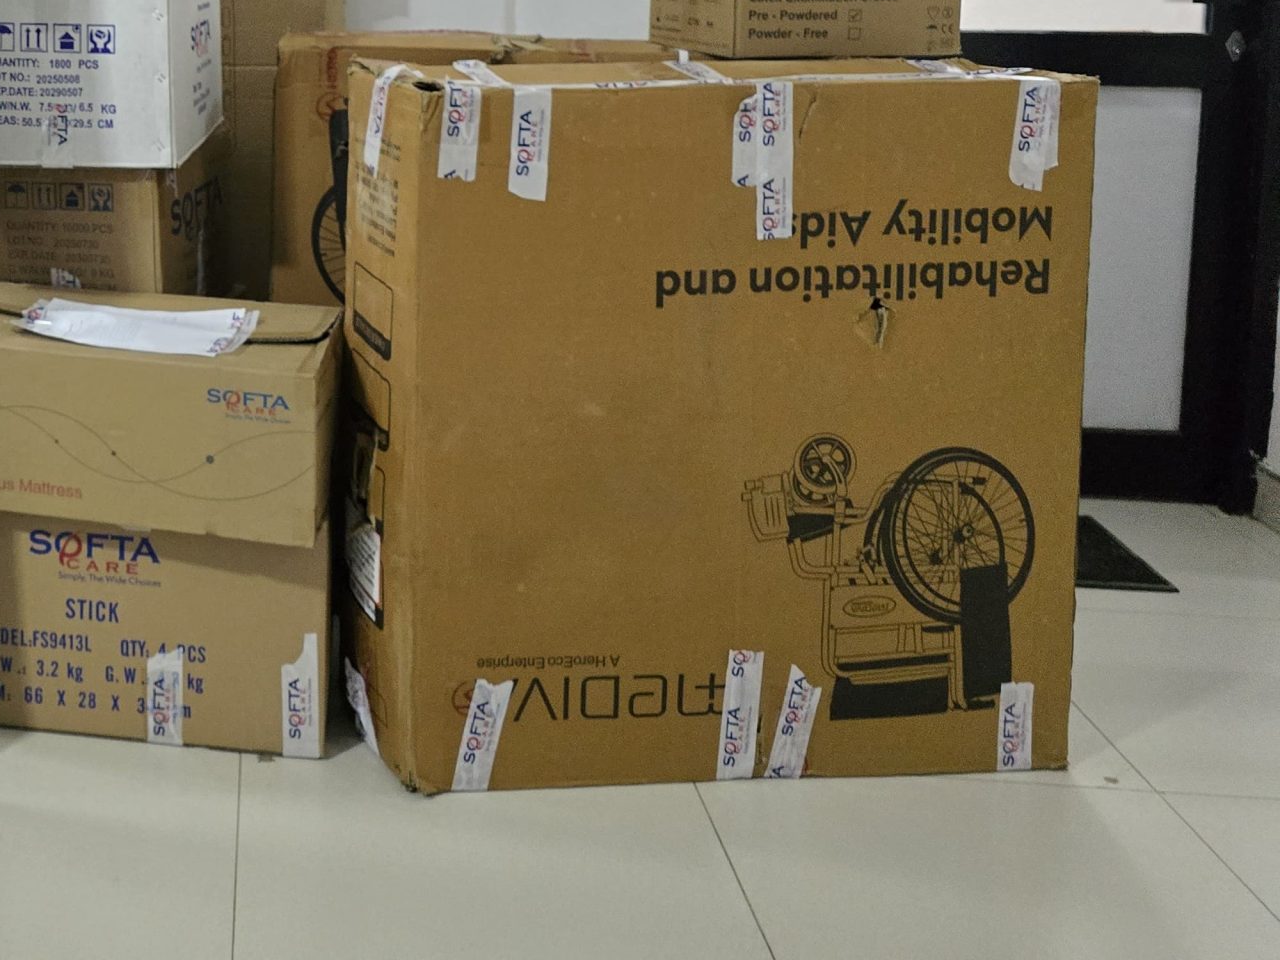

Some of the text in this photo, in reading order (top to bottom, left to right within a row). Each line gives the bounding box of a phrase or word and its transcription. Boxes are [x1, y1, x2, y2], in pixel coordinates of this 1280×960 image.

[749, 10, 768, 21] Pre
[779, 10, 838, 21] Powdered
[749, 28, 792, 39] Powder
[803, 28, 828, 39] Free
[78, 59, 99, 70] PCS
[100, 104, 117, 115] KG
[97, 119, 114, 129] CM
[792, 199, 1053, 249] Mobility Aid
[655, 259, 1050, 309] Rehabilitation and
[207, 388, 289, 410] SOFTA
[20, 478, 82, 499] Mattress
[29, 529, 160, 564] SOFTA
[66, 559, 138, 575] CARE
[65, 598, 119, 624] STICK
[121, 640, 149, 658] QTY:
[477, 656, 545, 670] Enterprise
[609, 654, 620, 667] A
[37, 660, 58, 677] 3.2
[67, 662, 83, 683] kg
[187, 673, 204, 694] kg
[24, 686, 43, 704] 66
[57, 690, 66, 706] X
[79, 692, 96, 709] 28
[111, 694, 119, 711] X
